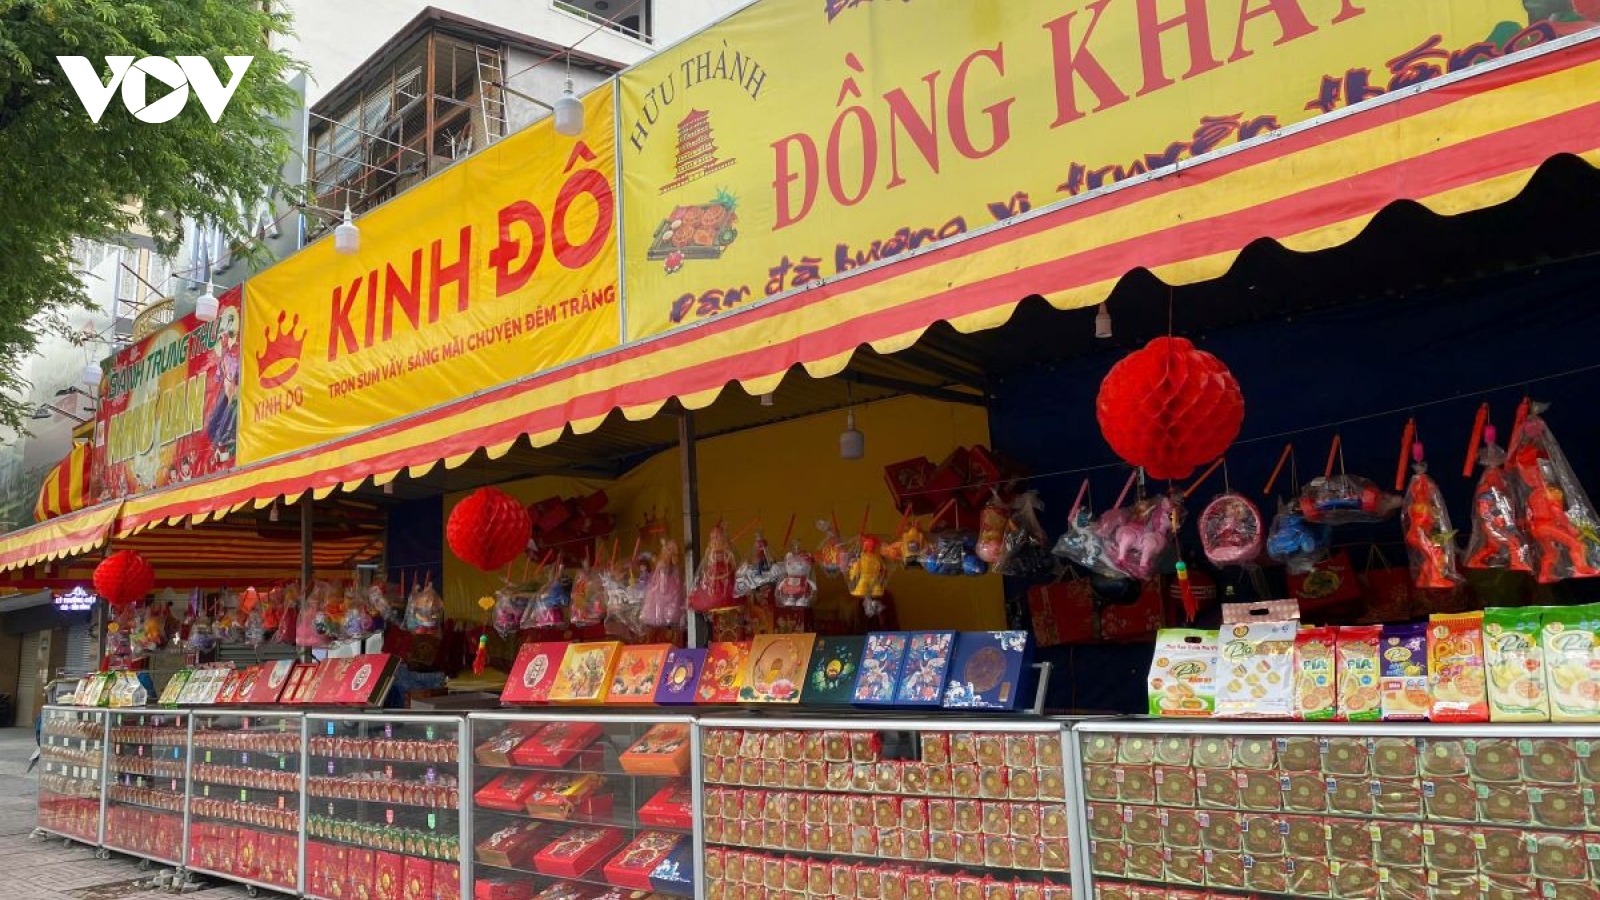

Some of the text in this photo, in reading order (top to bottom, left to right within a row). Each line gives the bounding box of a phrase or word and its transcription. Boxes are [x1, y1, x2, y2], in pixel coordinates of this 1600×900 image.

[770, 41, 1016, 231] ĐỒNG
[327, 225, 472, 363] KINH
[488, 140, 613, 298] ĐÔ
[357, 368, 380, 389] SUM
[525, 305, 557, 332] ĐÊM
[560, 285, 615, 319] TRĂNG
